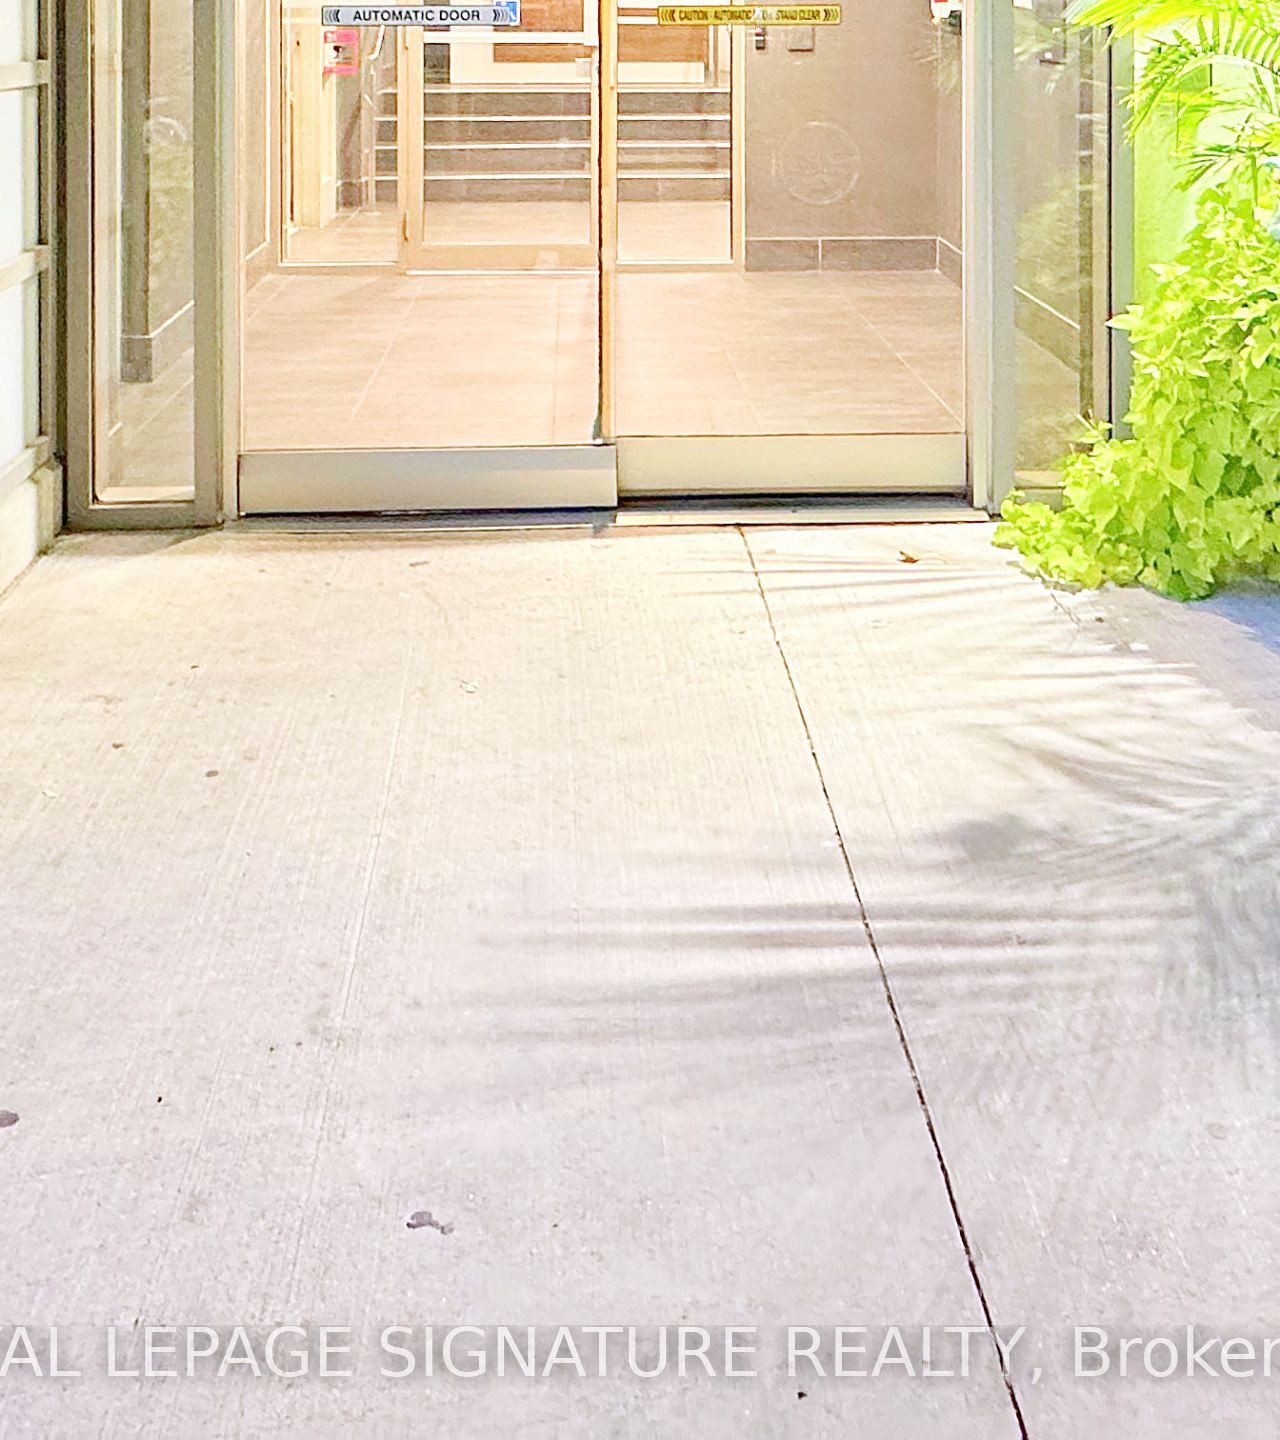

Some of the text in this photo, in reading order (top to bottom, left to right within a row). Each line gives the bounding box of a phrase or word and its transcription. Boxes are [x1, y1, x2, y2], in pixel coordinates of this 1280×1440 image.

[352, 9, 481, 22] AUTOMATIC DOOR
[678, 9, 708, 21] CAUTION
